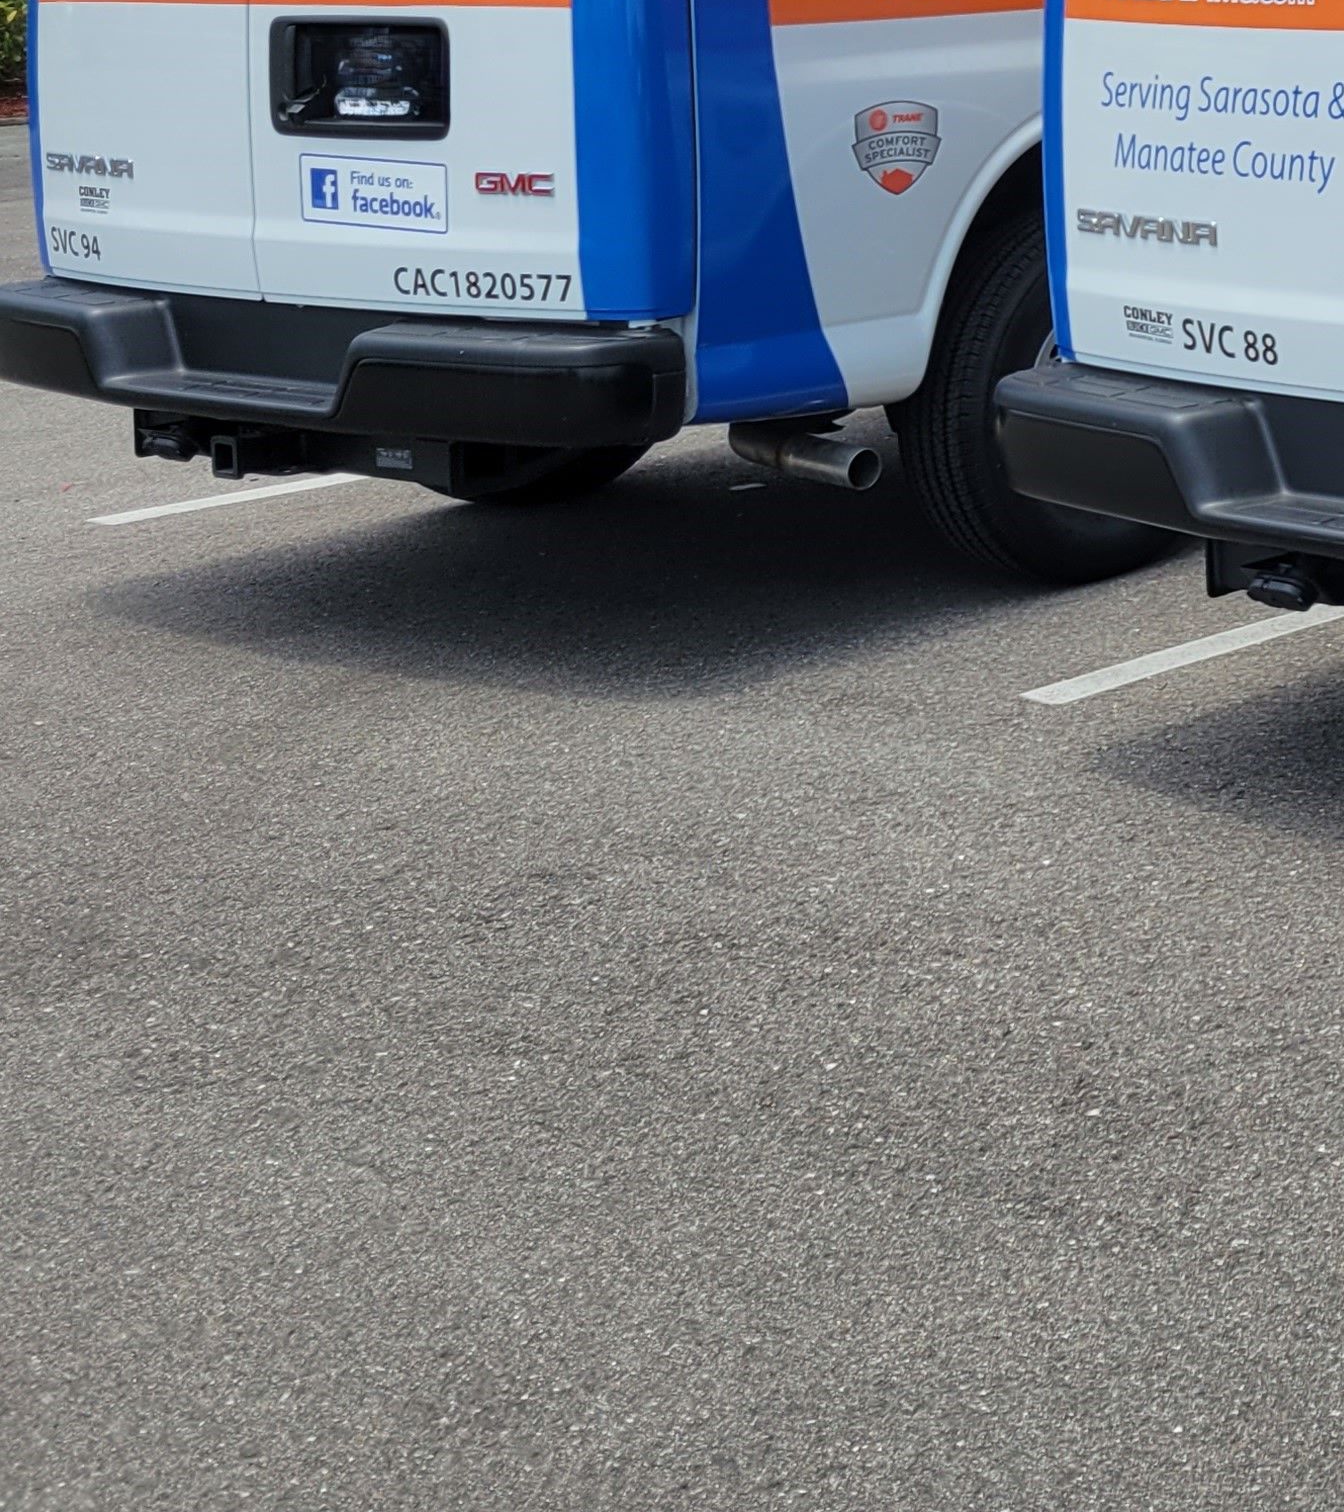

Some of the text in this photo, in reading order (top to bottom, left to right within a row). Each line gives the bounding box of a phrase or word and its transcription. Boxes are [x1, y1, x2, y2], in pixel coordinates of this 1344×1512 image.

[1101, 71, 1191, 121] Serving
[1199, 76, 1320, 118] Sarasota
[864, 146, 931, 163] SPECIALIST
[868, 135, 927, 150] COMFORT
[1114, 133, 1337, 194] Manatee County
[350, 171, 413, 189] Find us on:
[475, 172, 554, 196] GMC
[352, 189, 435, 219] facebook
[51, 226, 101, 261] SVC 94
[1077, 208, 1217, 247] SAVANA
[394, 267, 572, 302] CAC1820577
[1124, 305, 1173, 326] CONLEY
[1183, 317, 1236, 359] SVC
[1243, 332, 1279, 366] 88
